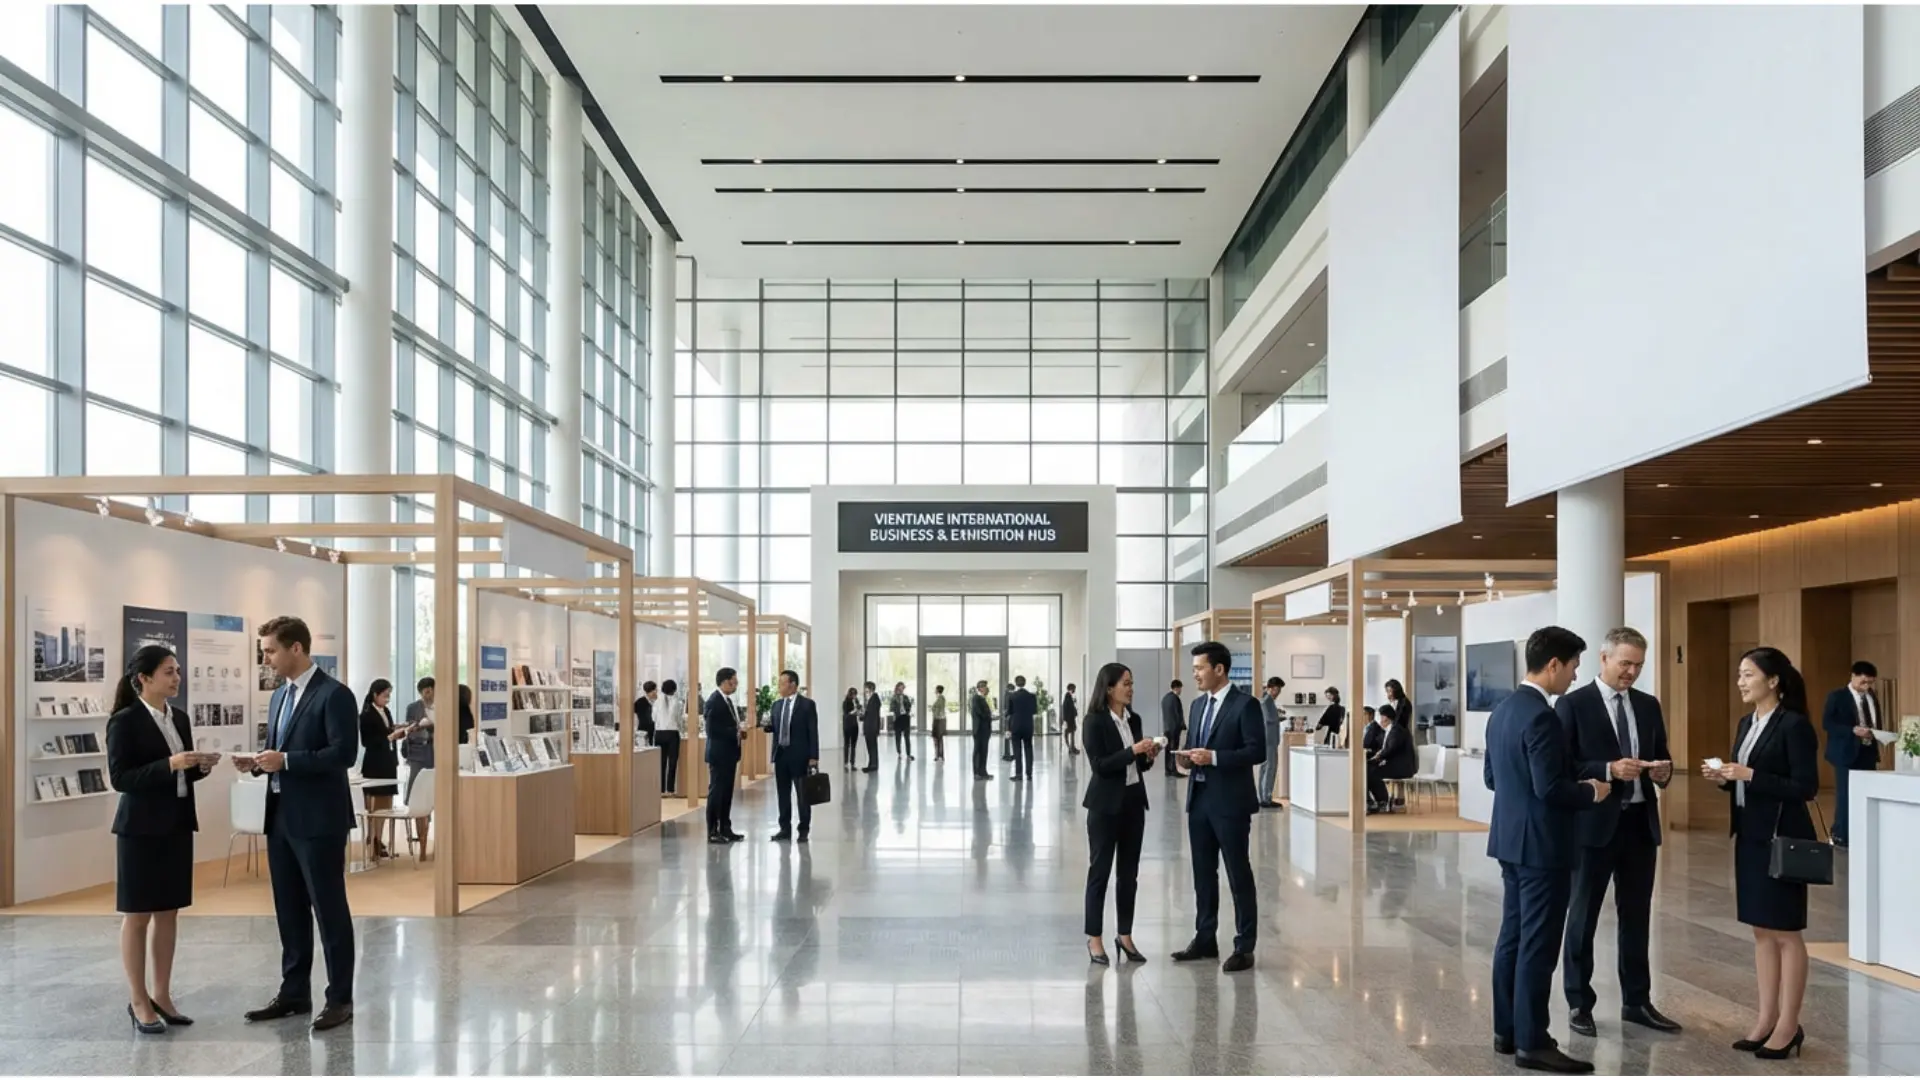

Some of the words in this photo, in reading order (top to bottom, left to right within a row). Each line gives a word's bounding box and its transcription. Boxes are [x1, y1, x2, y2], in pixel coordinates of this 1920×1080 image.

[874, 512, 944, 526] VIENTIANE
[870, 528, 934, 542] BUSINESS
[936, 528, 948, 542] &
